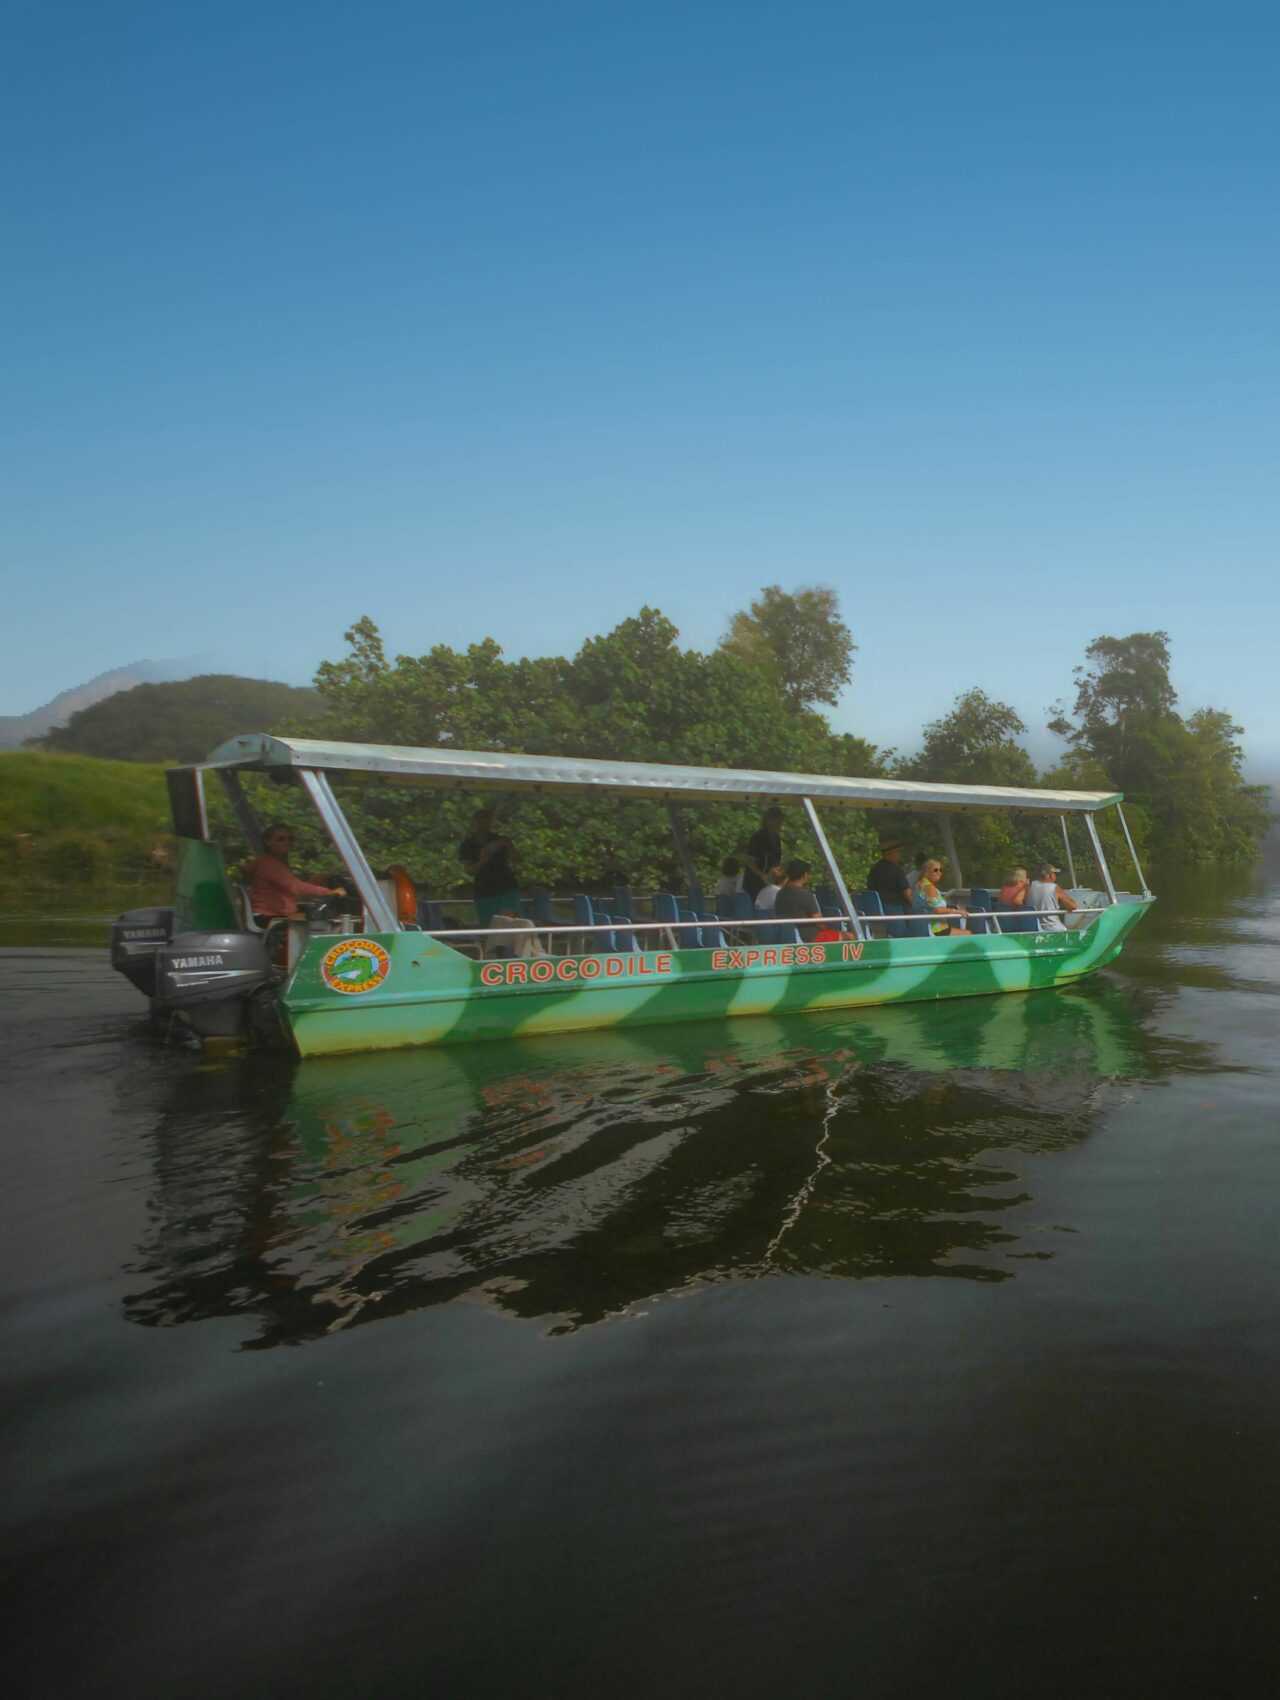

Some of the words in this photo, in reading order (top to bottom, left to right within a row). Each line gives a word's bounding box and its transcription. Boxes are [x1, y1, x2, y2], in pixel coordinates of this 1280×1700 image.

[123, 928, 167, 939] YAMAHA
[325, 940, 387, 967] CROCODILE
[172, 955, 223, 969] YAMAHA
[481, 954, 672, 986] CROCODILE
[712, 945, 825, 970] EXPRESS
[842, 943, 863, 961] IV
[331, 976, 382, 992] EXPRESS
